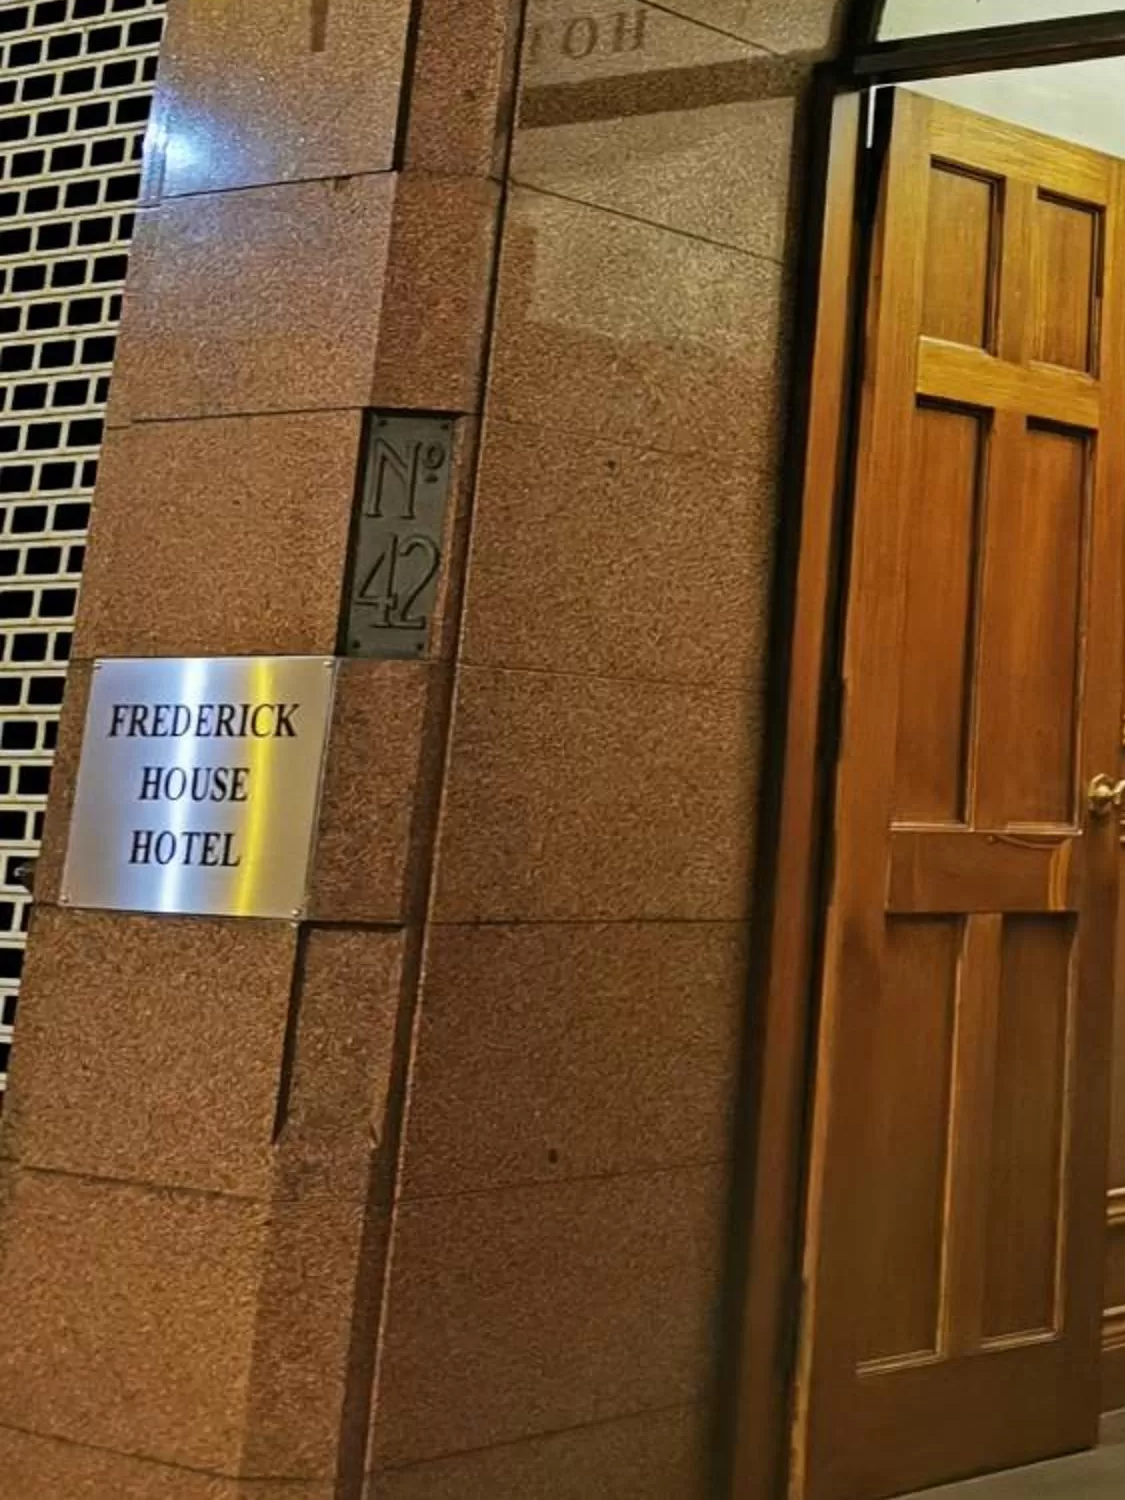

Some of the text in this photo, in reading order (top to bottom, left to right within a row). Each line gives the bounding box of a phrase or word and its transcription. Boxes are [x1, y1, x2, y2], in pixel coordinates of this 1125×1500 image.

[358, 532, 442, 631] 42
[109, 703, 301, 738] FREDERICK
[139, 766, 250, 803] HOUSE
[128, 829, 241, 867] HOTEL
